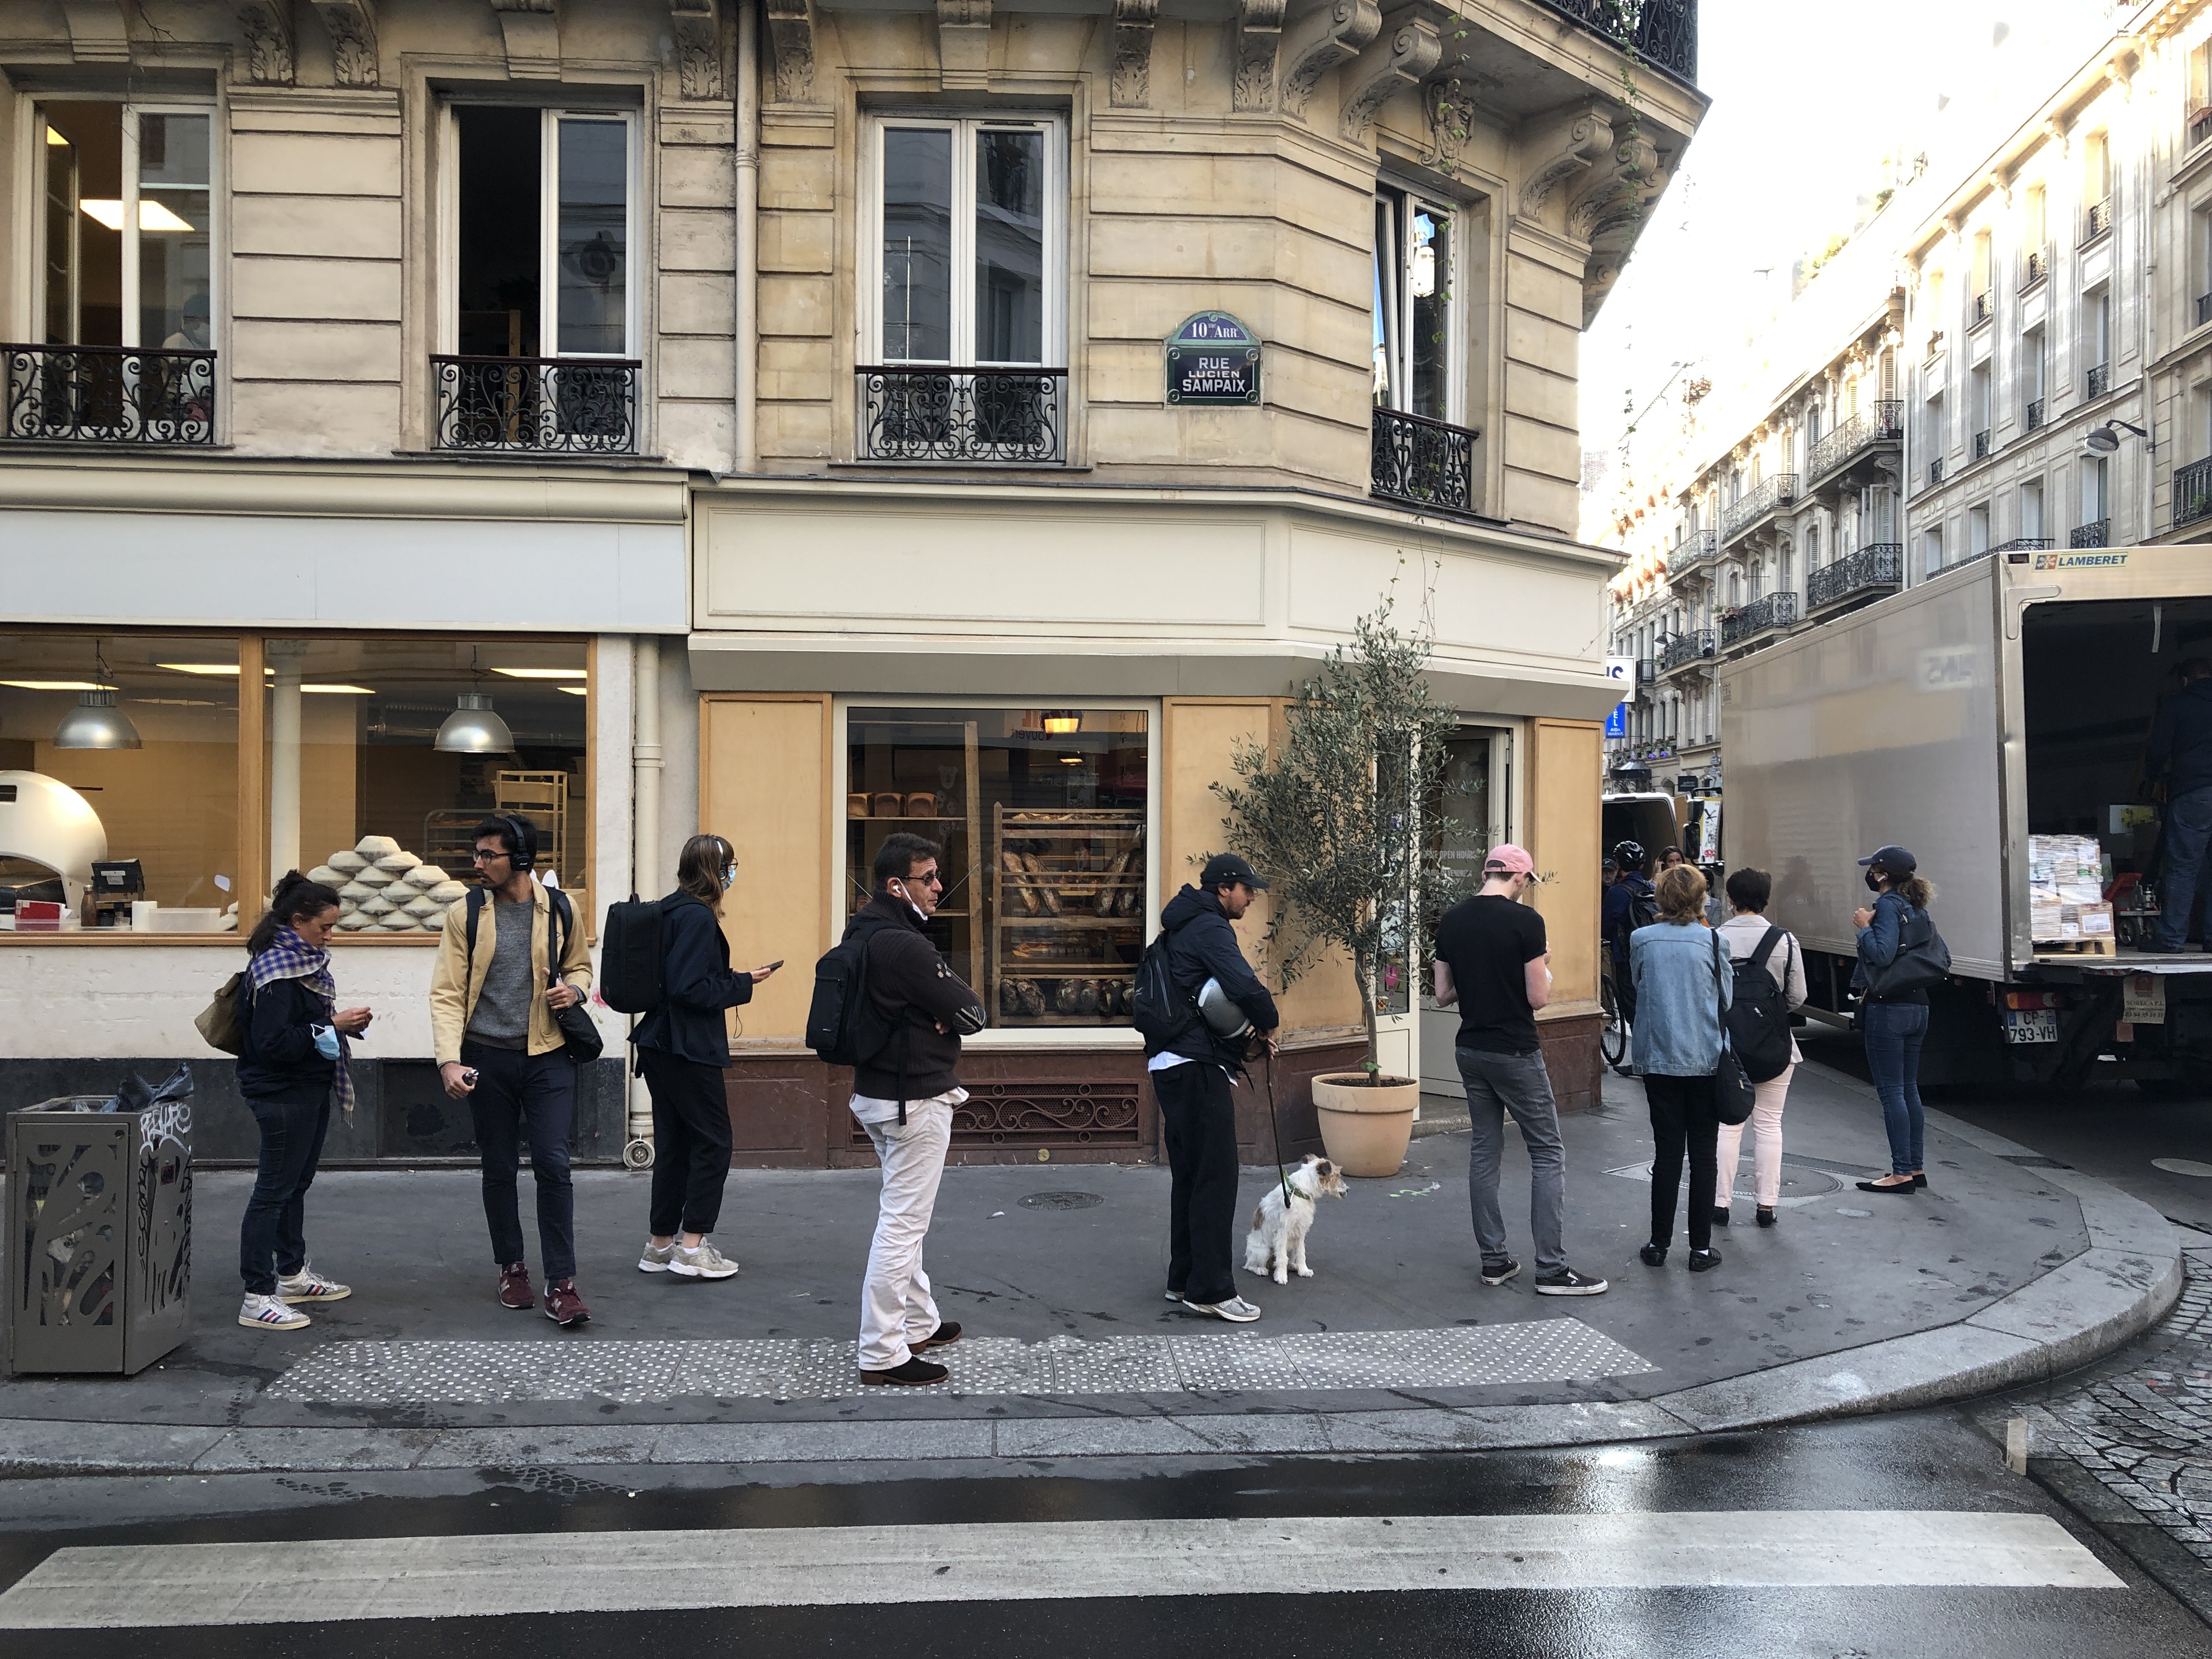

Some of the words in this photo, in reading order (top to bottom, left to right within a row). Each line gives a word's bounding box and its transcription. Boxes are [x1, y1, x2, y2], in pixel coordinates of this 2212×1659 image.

[1199, 357, 1230, 370] RUE
[1182, 379, 1245, 392] SAMPAIX
[2058, 555, 2128, 566] LAMBERET
[1440, 850, 1454, 859] OPEN
[2010, 1025, 2056, 1042] 793-VH
